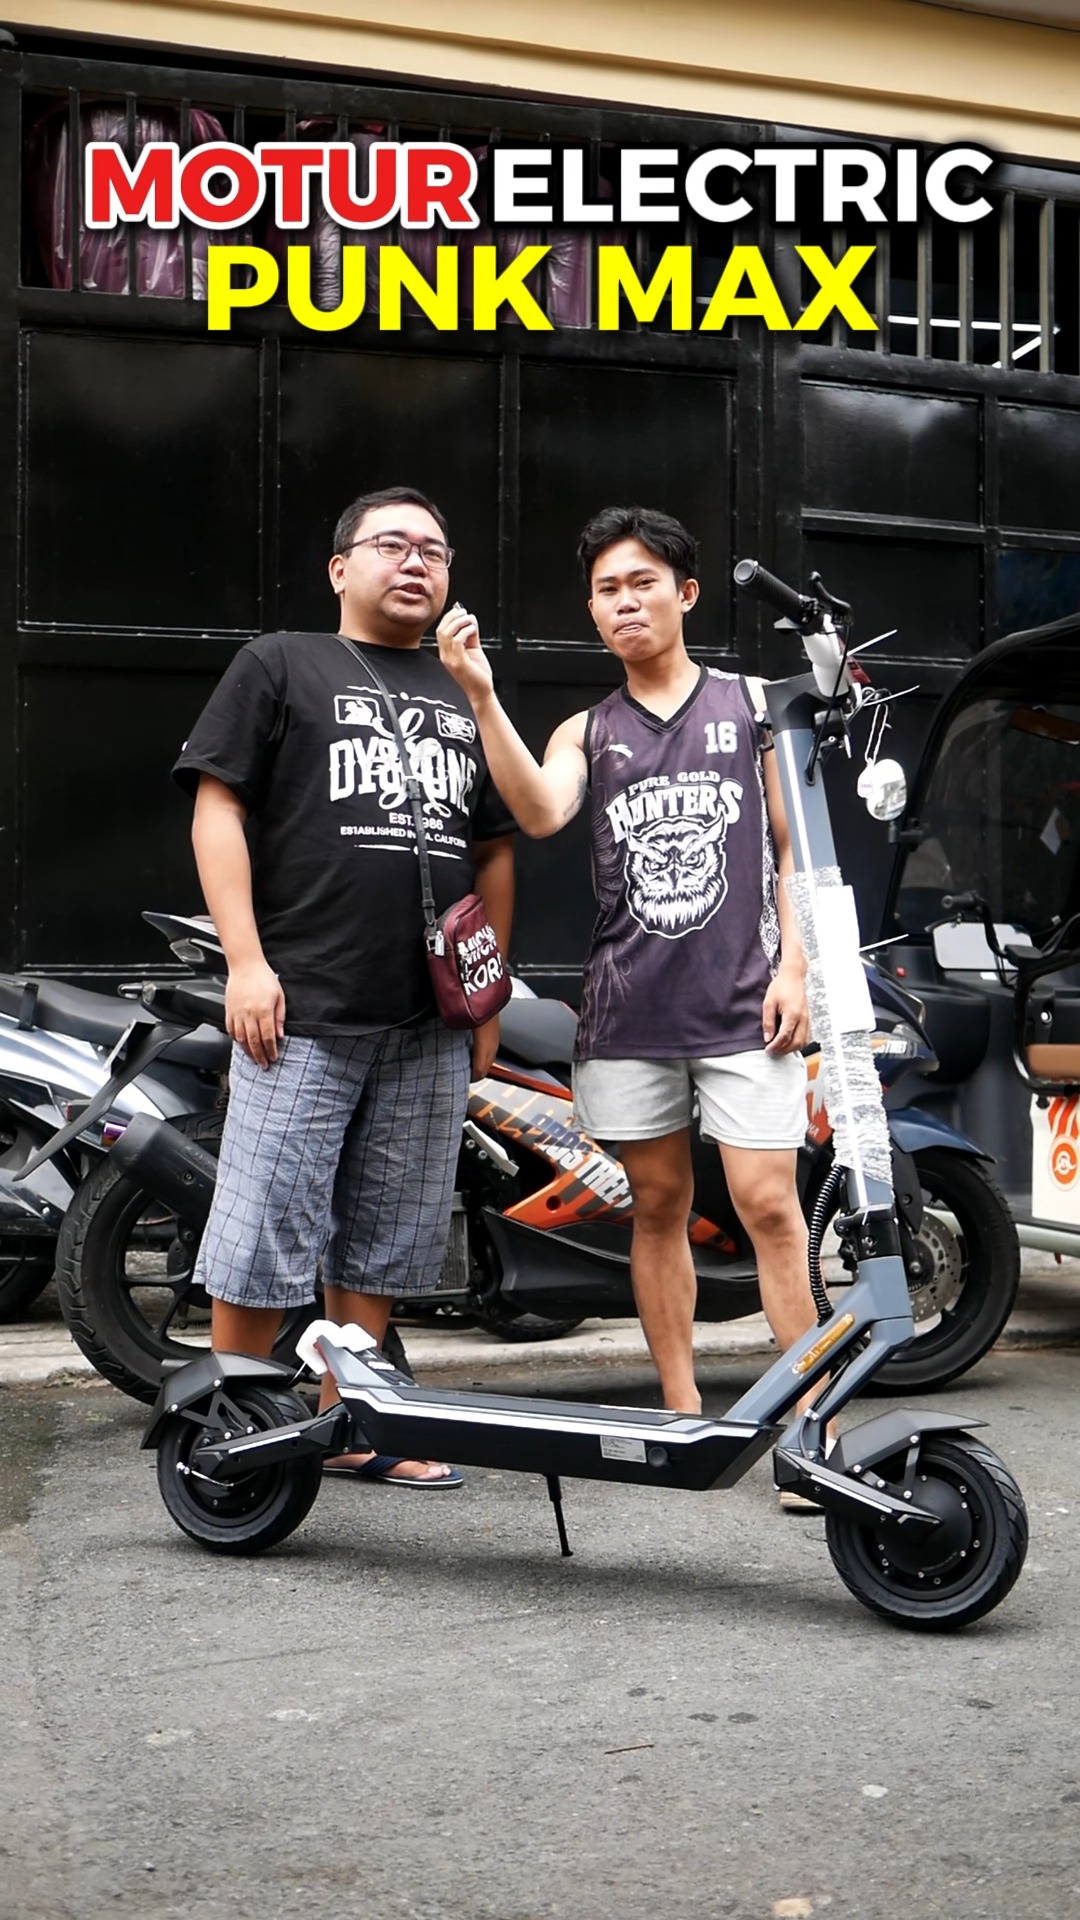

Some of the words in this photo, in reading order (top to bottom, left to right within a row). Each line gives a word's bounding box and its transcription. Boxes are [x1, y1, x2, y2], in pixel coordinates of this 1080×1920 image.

[704, 721, 738, 754] 16
[628, 776, 670, 796] PURE
[677, 770, 720, 782] GOLD
[388, 812, 415, 826] EST.
[422, 817, 444, 830] 986
[605, 780, 743, 843] HUNTERS
[340, 826, 406, 838] ESTABLISHED
